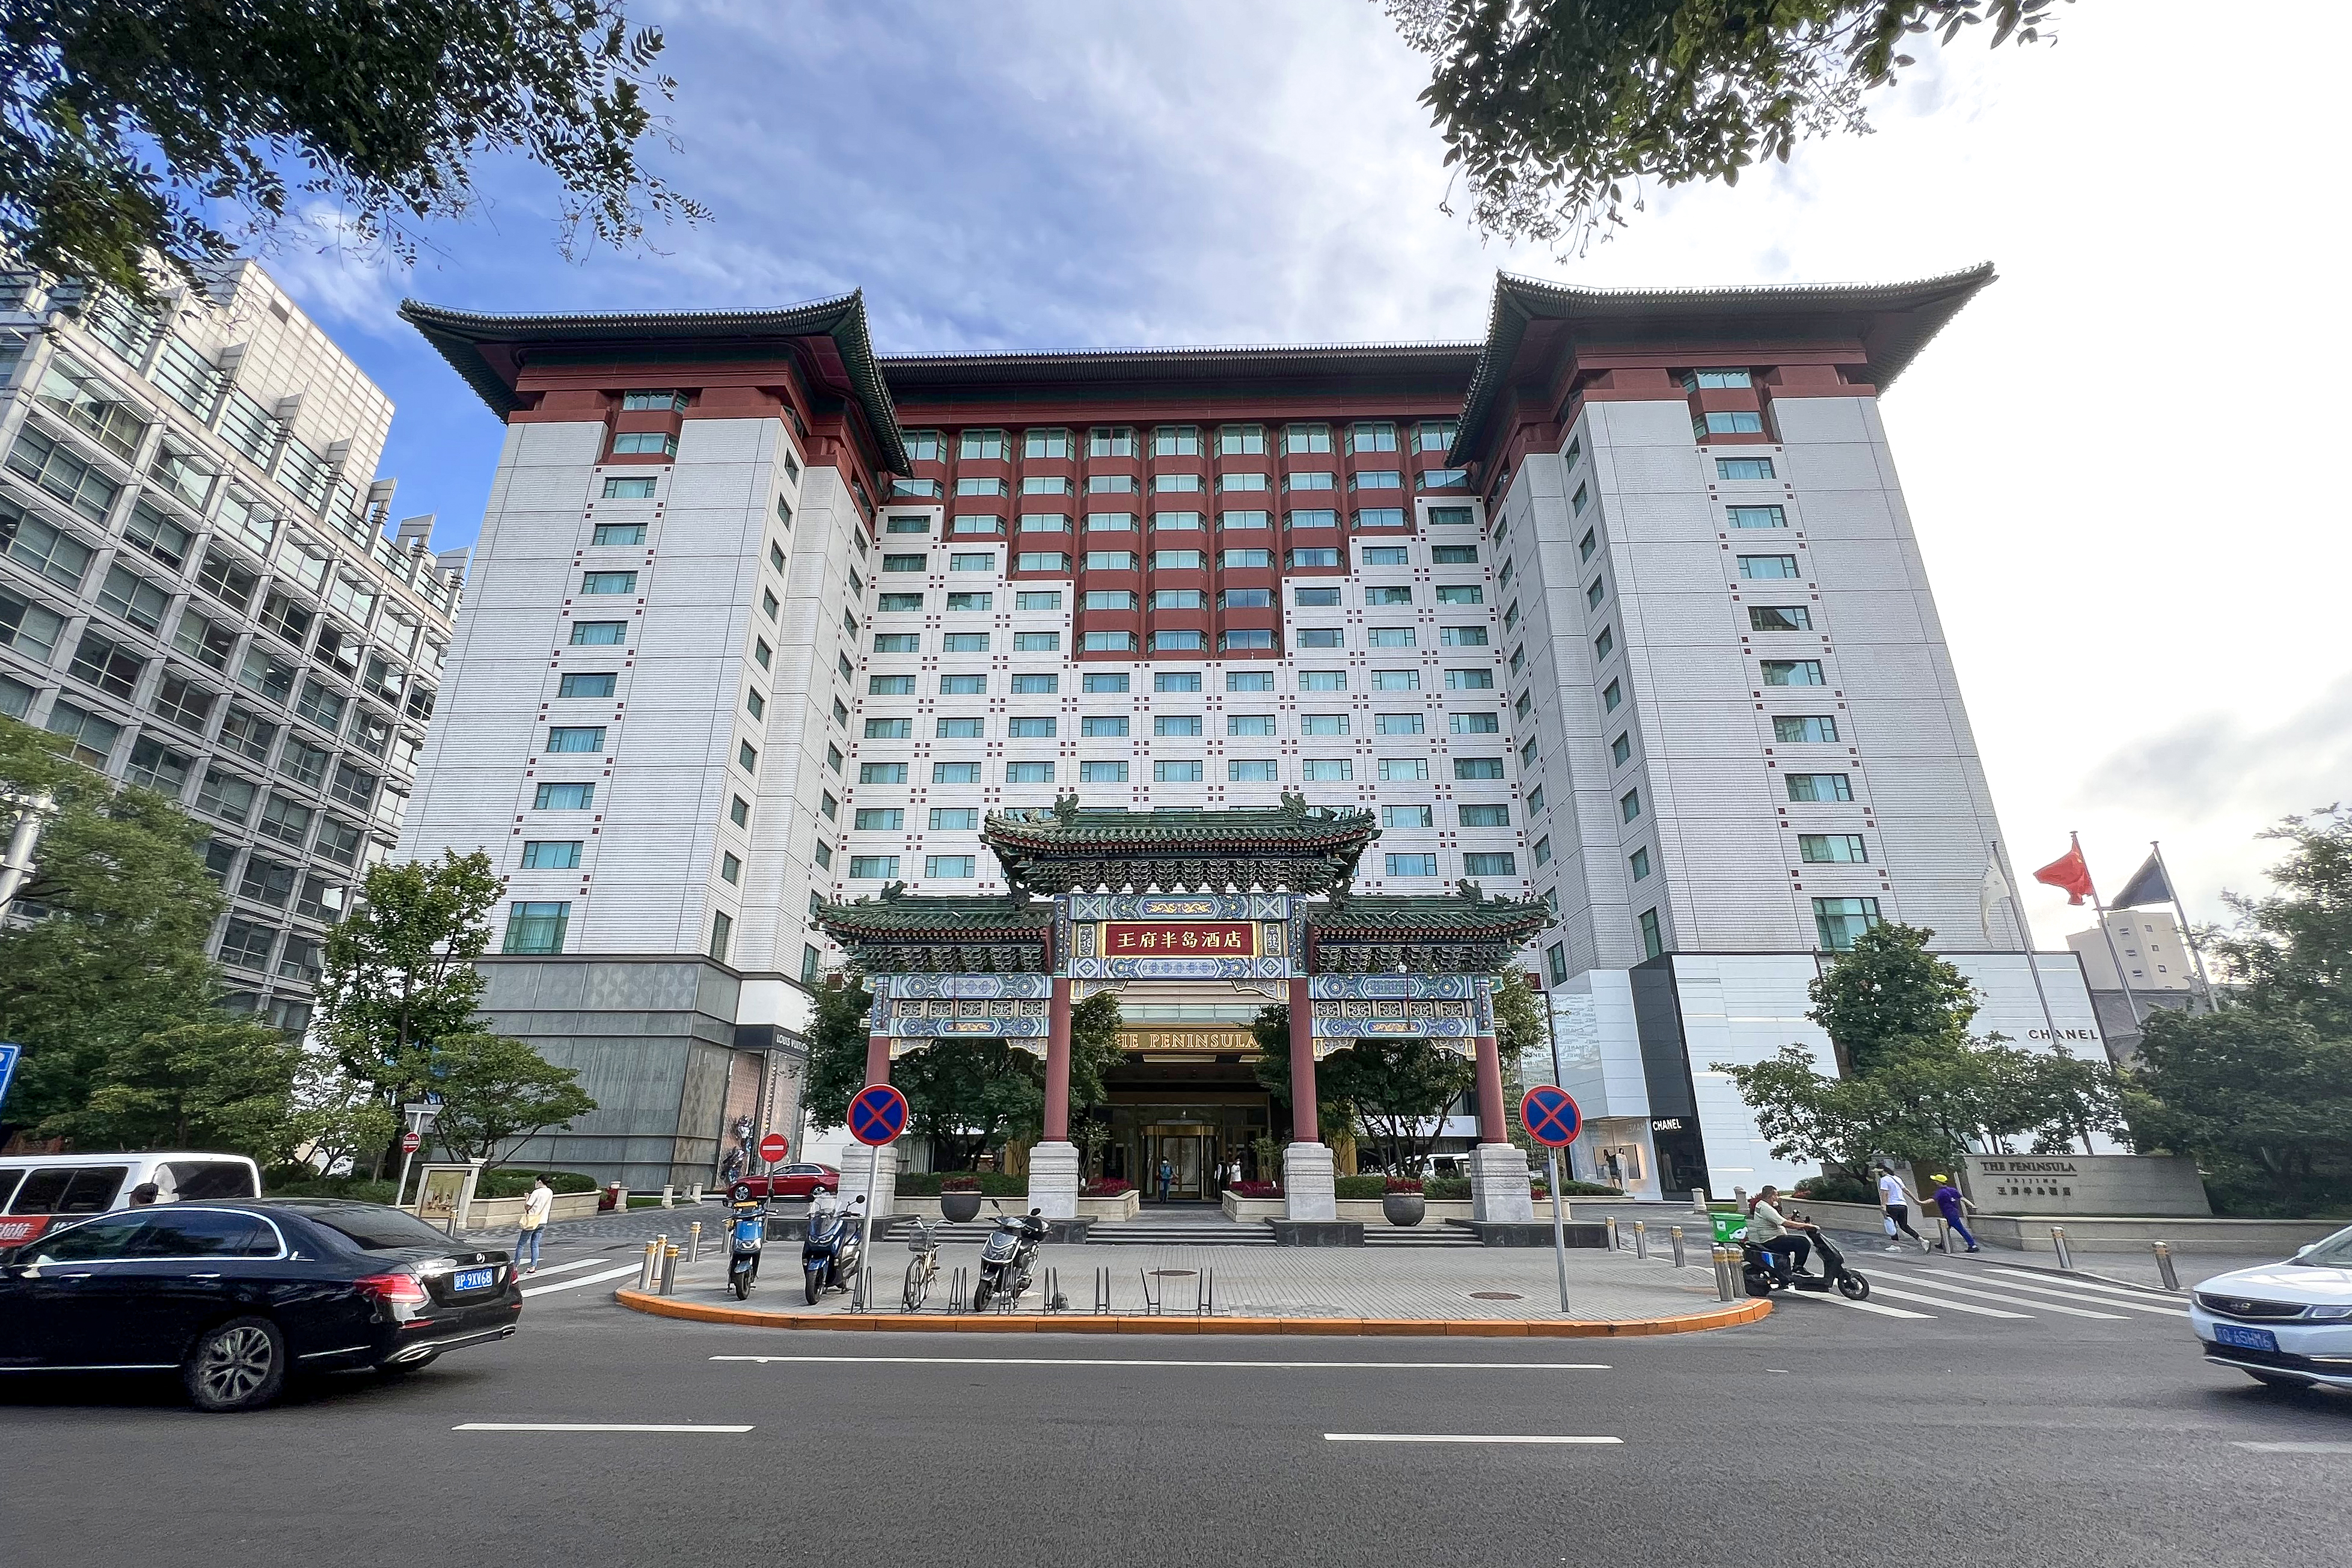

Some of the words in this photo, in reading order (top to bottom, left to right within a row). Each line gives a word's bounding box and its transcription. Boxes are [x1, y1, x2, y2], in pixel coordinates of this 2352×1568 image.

[1117, 930, 1242, 948] 王府半岛酒店
[1149, 1034, 1259, 1048] PENINSULA
[2029, 1029, 2098, 1040] CHANEL
[1652, 1118, 1682, 1132] CHANEL
[1980, 1162, 2006, 1171] THE
[2008, 1162, 2077, 1172] PENINSULA
